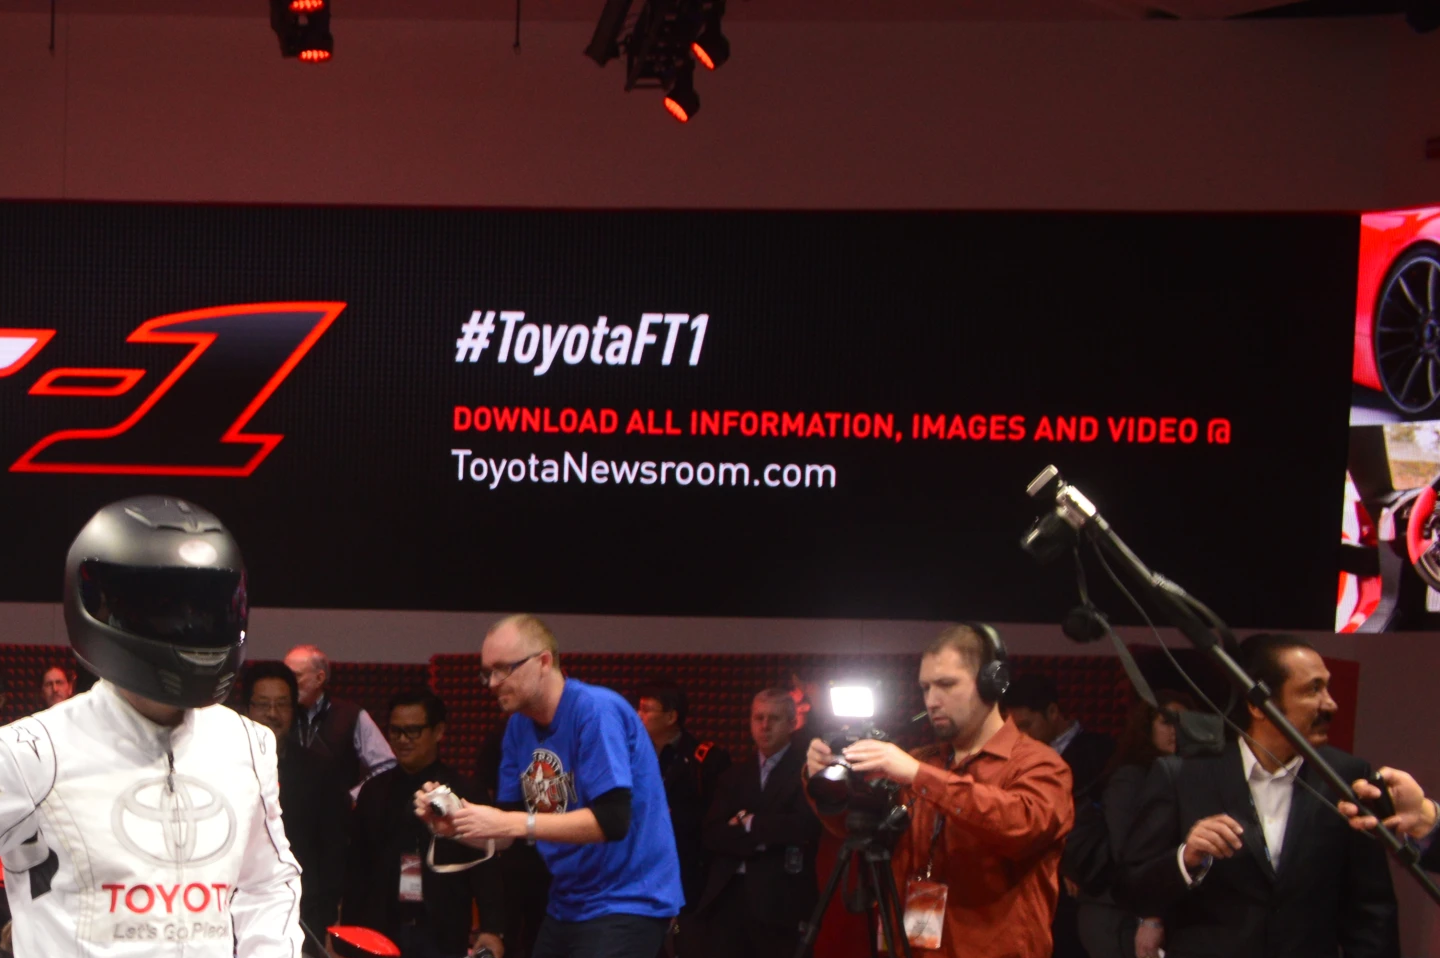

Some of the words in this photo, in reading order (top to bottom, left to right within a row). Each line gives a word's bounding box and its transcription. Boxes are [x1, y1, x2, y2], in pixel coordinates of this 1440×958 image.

[454, 310, 710, 377] #ToyotaFT1
[453, 405, 619, 435] DOWNLOAD
[625, 408, 683, 436] ALL
[690, 409, 903, 443] INFORMATION,
[911, 413, 1027, 441] IMAGES
[1033, 415, 1099, 443] AND
[1107, 416, 1199, 444] VIDEO
[1206, 417, 1232, 445] @
[450, 448, 837, 490] ToyotaNewsroom.com
[101, 882, 232, 915] TOYOT
[163, 922, 189, 940] Go
